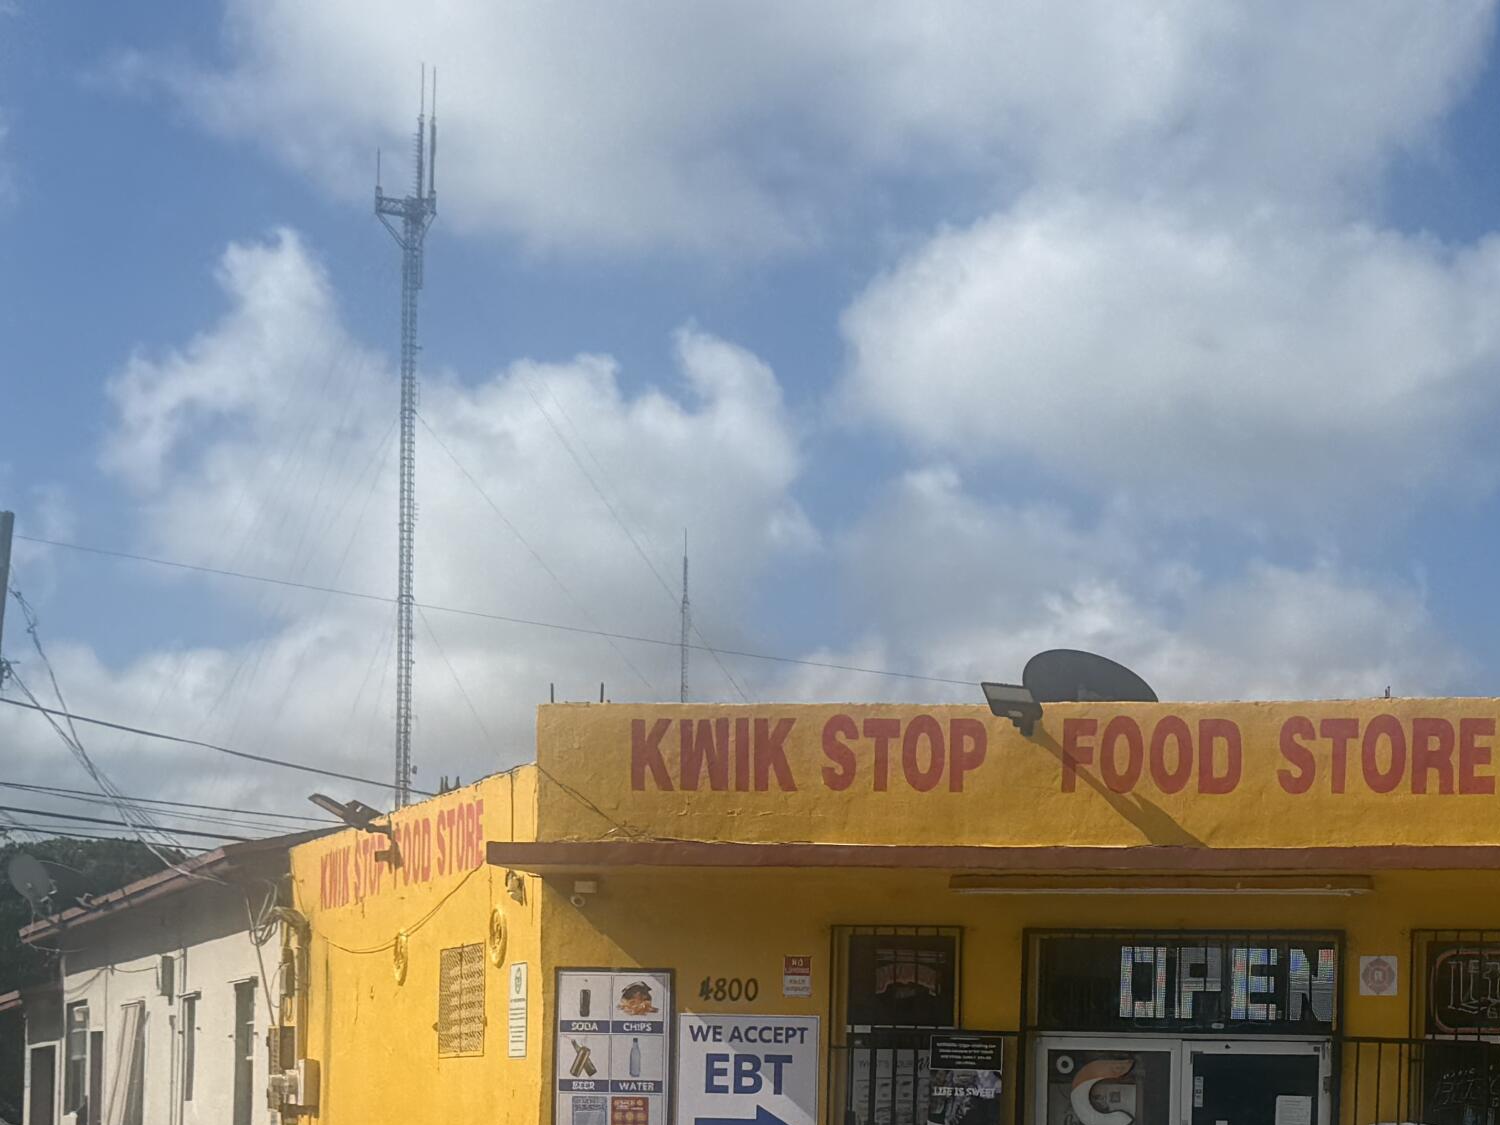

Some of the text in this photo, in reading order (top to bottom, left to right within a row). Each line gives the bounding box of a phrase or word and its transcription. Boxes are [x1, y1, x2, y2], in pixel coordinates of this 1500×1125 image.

[631, 713, 1496, 795] KWIK STOP FOOD STORE
[320, 845, 351, 912] KWIK
[437, 799, 483, 876] STORE
[699, 976, 759, 1001] 4800
[1120, 946, 1334, 1022] OPEN
[571, 1022, 598, 1031] SODA
[623, 1023, 652, 1032] CHIPS
[689, 1024, 808, 1044] WE ACCEPT
[704, 1053, 793, 1095] EBT
[572, 1081, 595, 1090] BEER
[619, 1082, 654, 1091] WATER
[933, 1086, 996, 1099] LIFE IS SWEET
